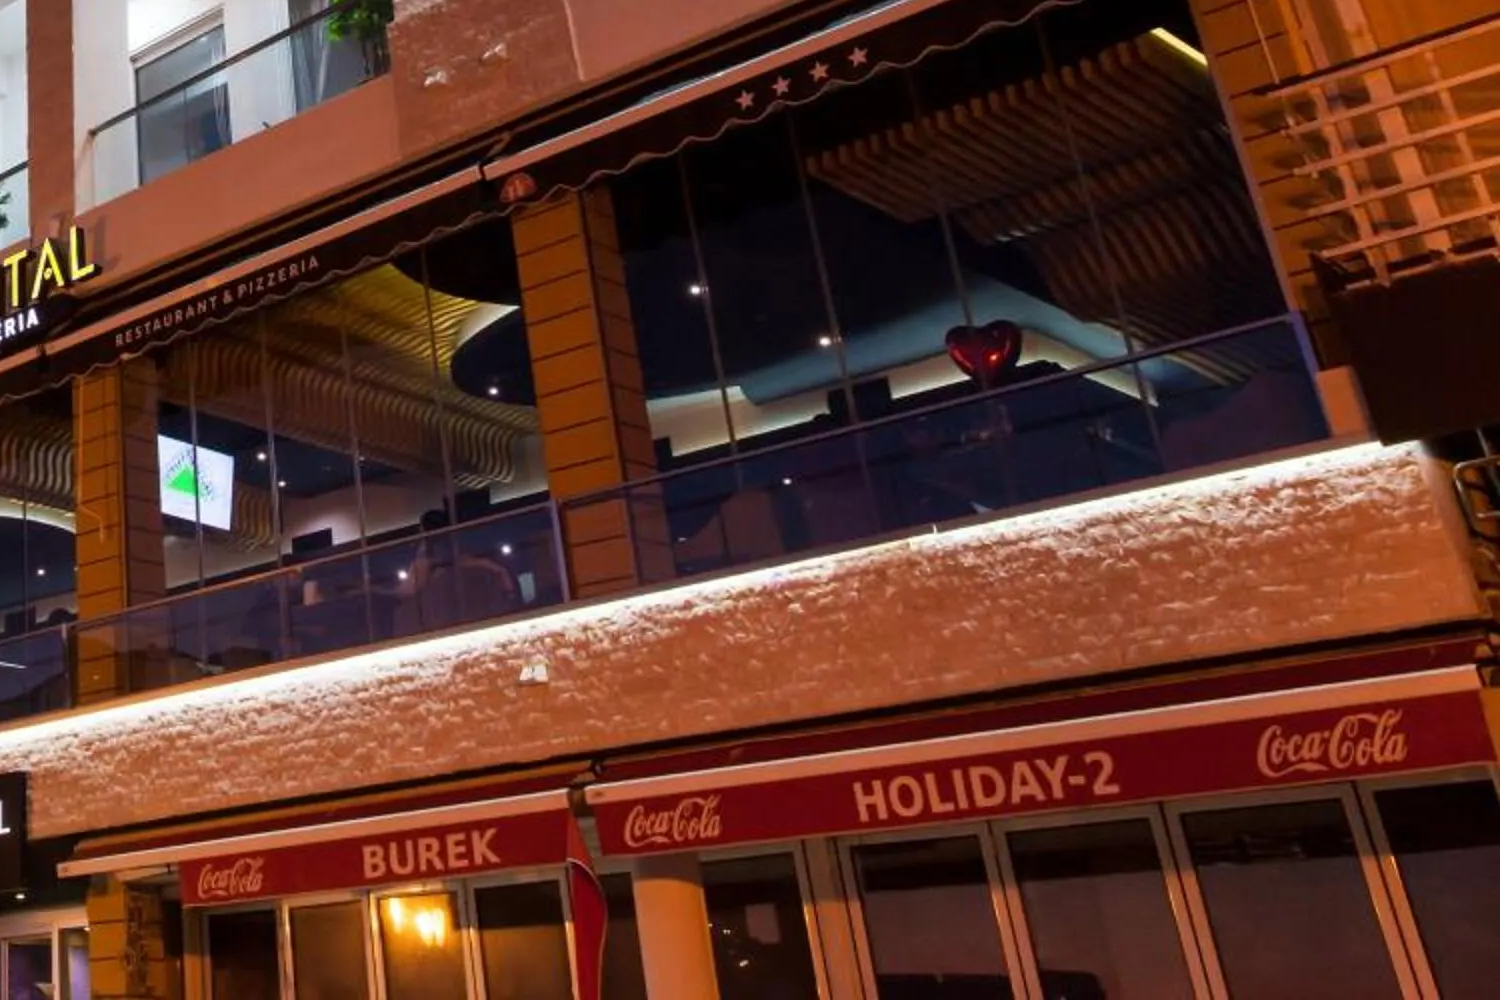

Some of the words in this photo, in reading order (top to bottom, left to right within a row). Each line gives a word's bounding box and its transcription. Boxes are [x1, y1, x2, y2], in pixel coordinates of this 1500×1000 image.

[114, 293, 218, 348] RESTAURANT
[222, 288, 234, 305] &
[237, 255, 320, 300] PIZZERIA
[1257, 708, 1408, 778] Coca-Cola
[853, 750, 1120, 823] HOLIDAY-2
[624, 794, 722, 848] Coca-Cola
[197, 856, 264, 899] Coca-Cola
[361, 827, 501, 880] BUREK
